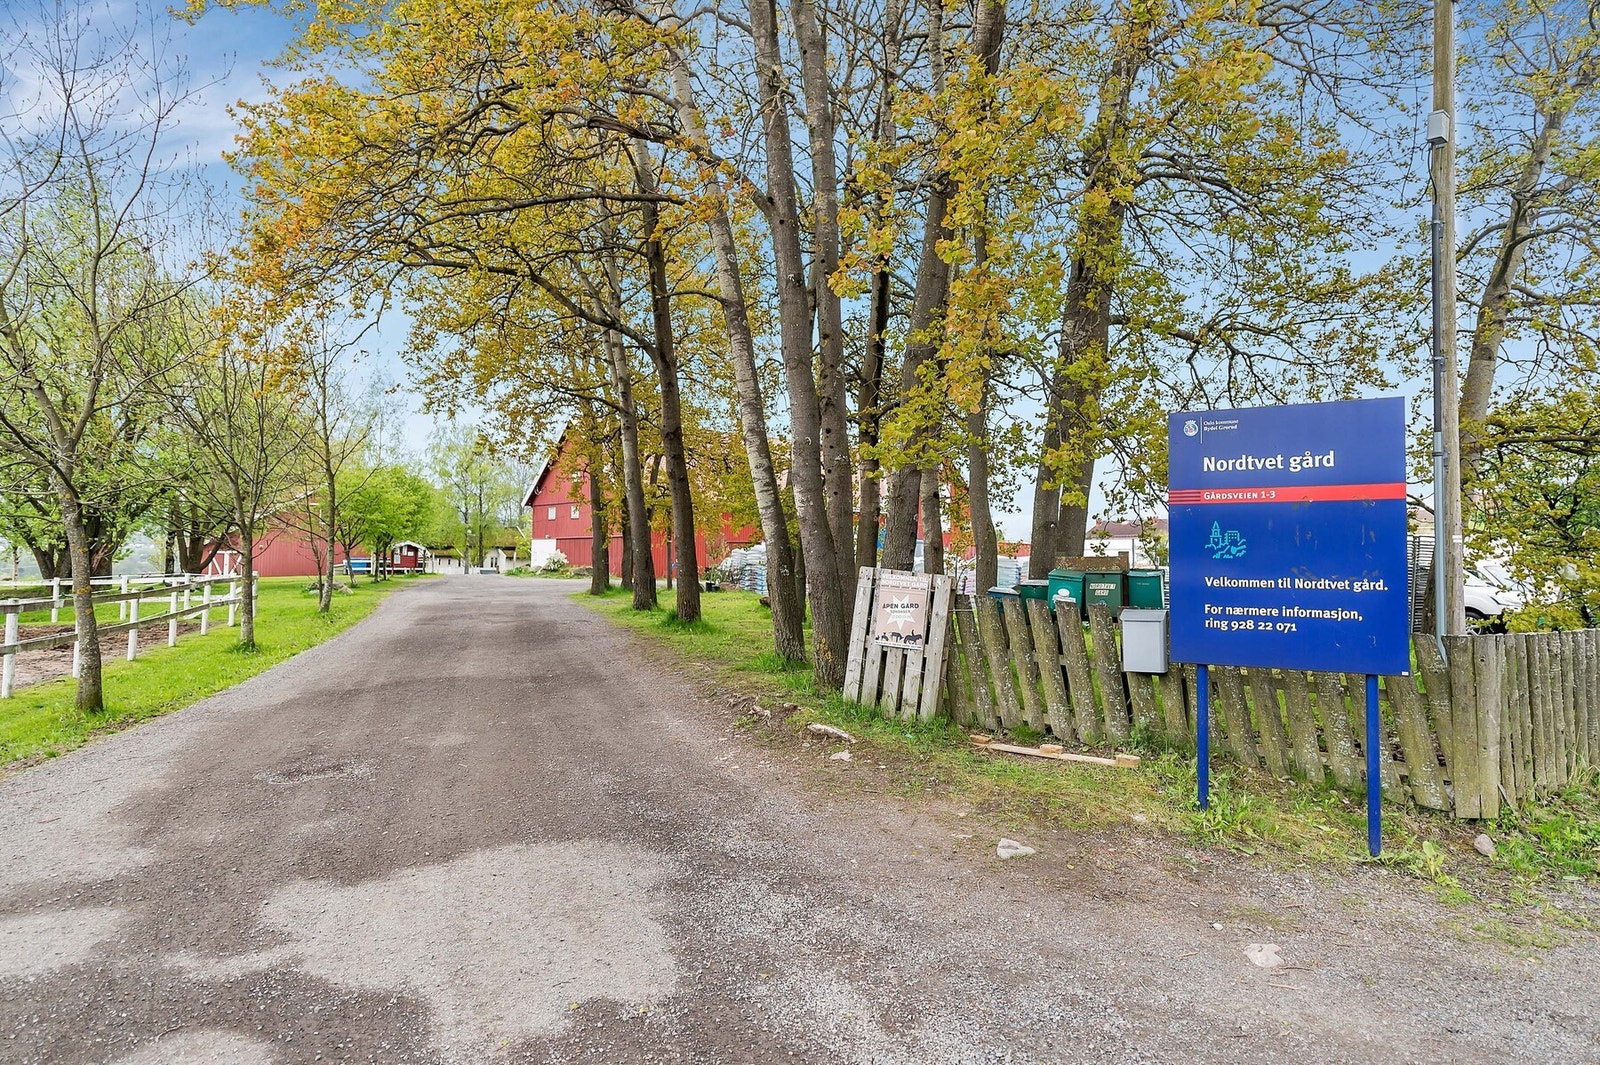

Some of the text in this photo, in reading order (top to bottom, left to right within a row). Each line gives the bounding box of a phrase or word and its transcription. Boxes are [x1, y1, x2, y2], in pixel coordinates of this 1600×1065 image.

[1203, 450, 1335, 472] Nordtvet gård
[1203, 490, 1276, 500] GÅRDSVEIEN 1-3
[1204, 576, 1389, 592] Velkommen til Nordtvet gård.
[1204, 603, 1363, 622] For nærmere informasjon,
[1204, 617, 1297, 634] ring 928 22 071
